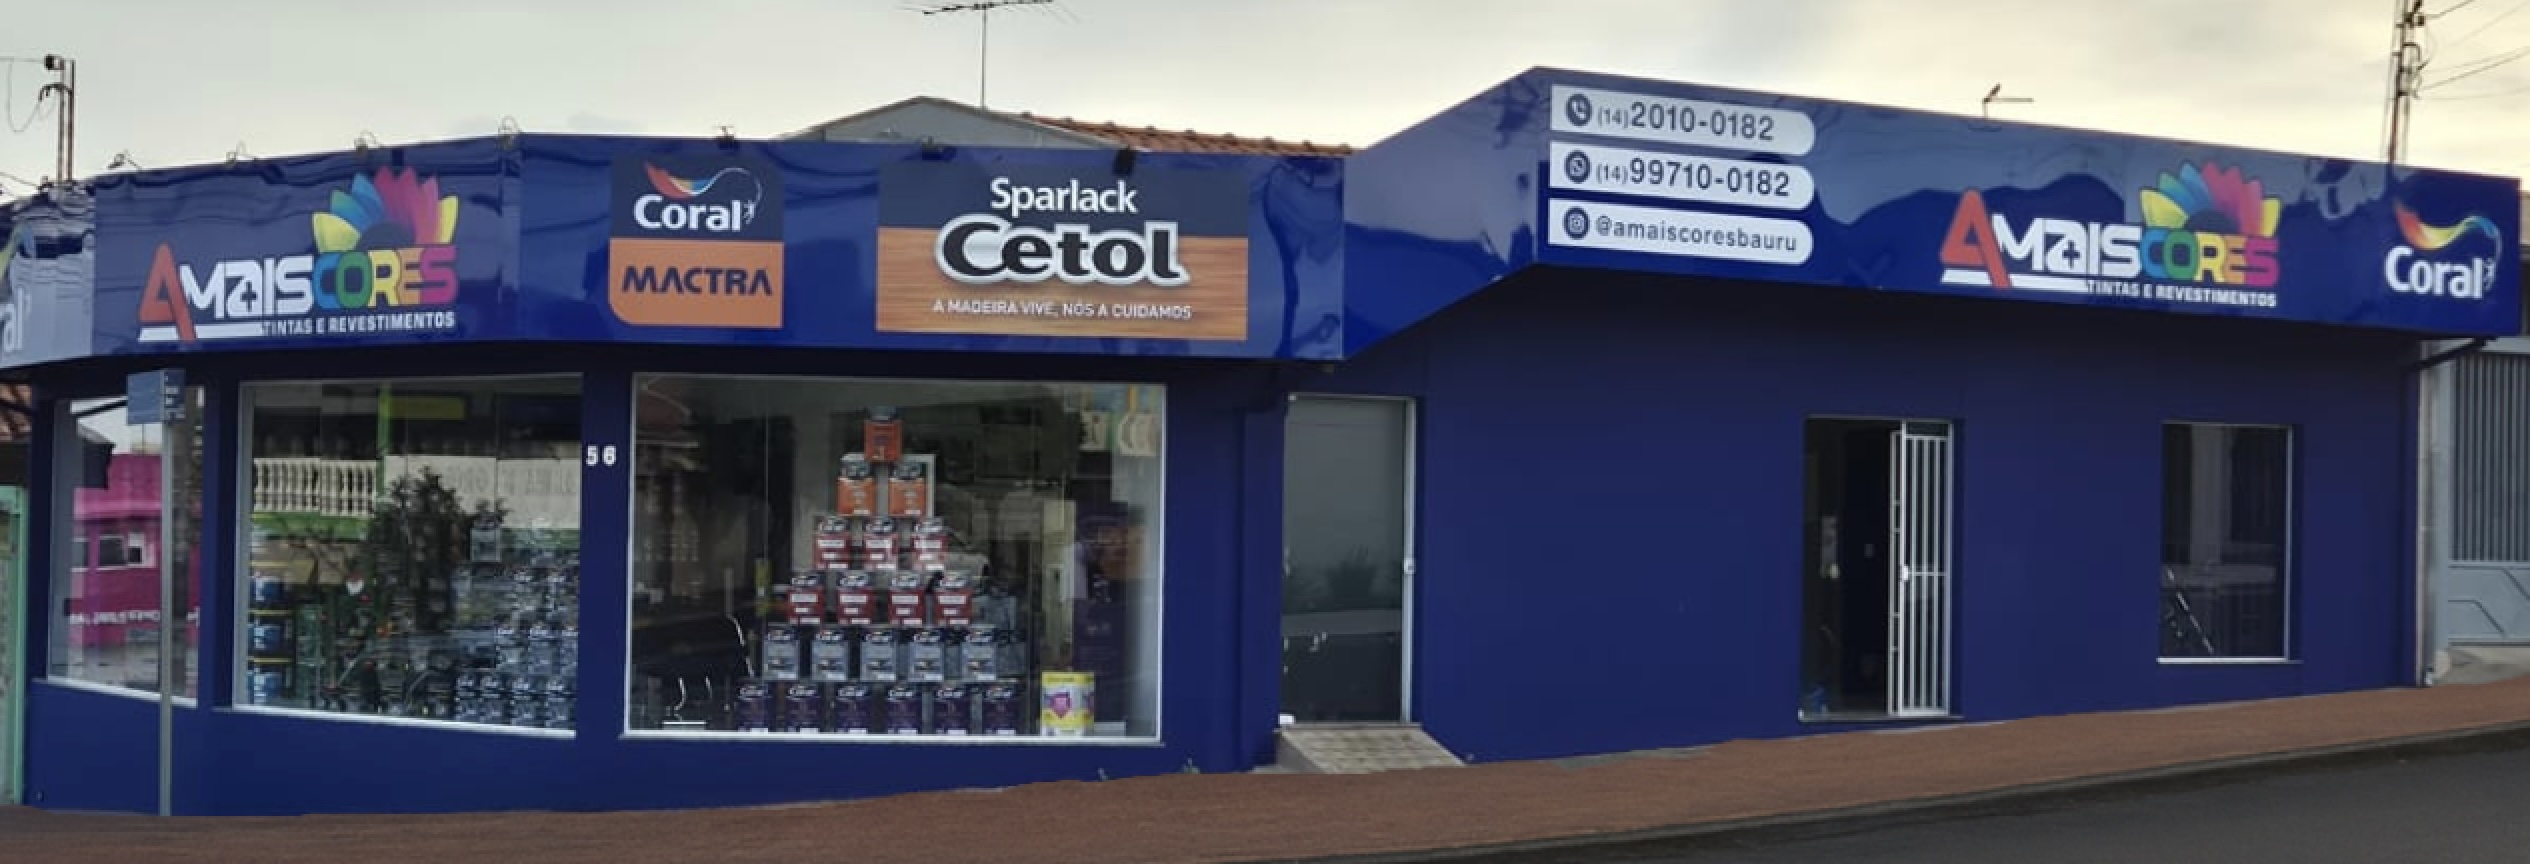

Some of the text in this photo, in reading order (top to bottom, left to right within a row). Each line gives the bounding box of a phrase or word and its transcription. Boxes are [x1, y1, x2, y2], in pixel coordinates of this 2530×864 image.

[633, 195, 741, 233] Coral
[990, 177, 1138, 217] Sparlack
[936, 215, 1188, 286] Cetol
[1596, 215, 1797, 252] @amaiscoresbauru
[622, 266, 772, 297] MACTRA
[2385, 246, 2484, 299] Coral
[932, 298, 945, 314] A
[948, 299, 1019, 315] MADEIRA
[1063, 299, 1095, 317] NÓS
[1098, 303, 1108, 317] A
[1112, 304, 1192, 321] CUIDAMOS
[2088, 279, 2277, 309] TINTAS E REVESTIMENTOS
[264, 310, 456, 337] TINTAS E REVESTIMENTOS
